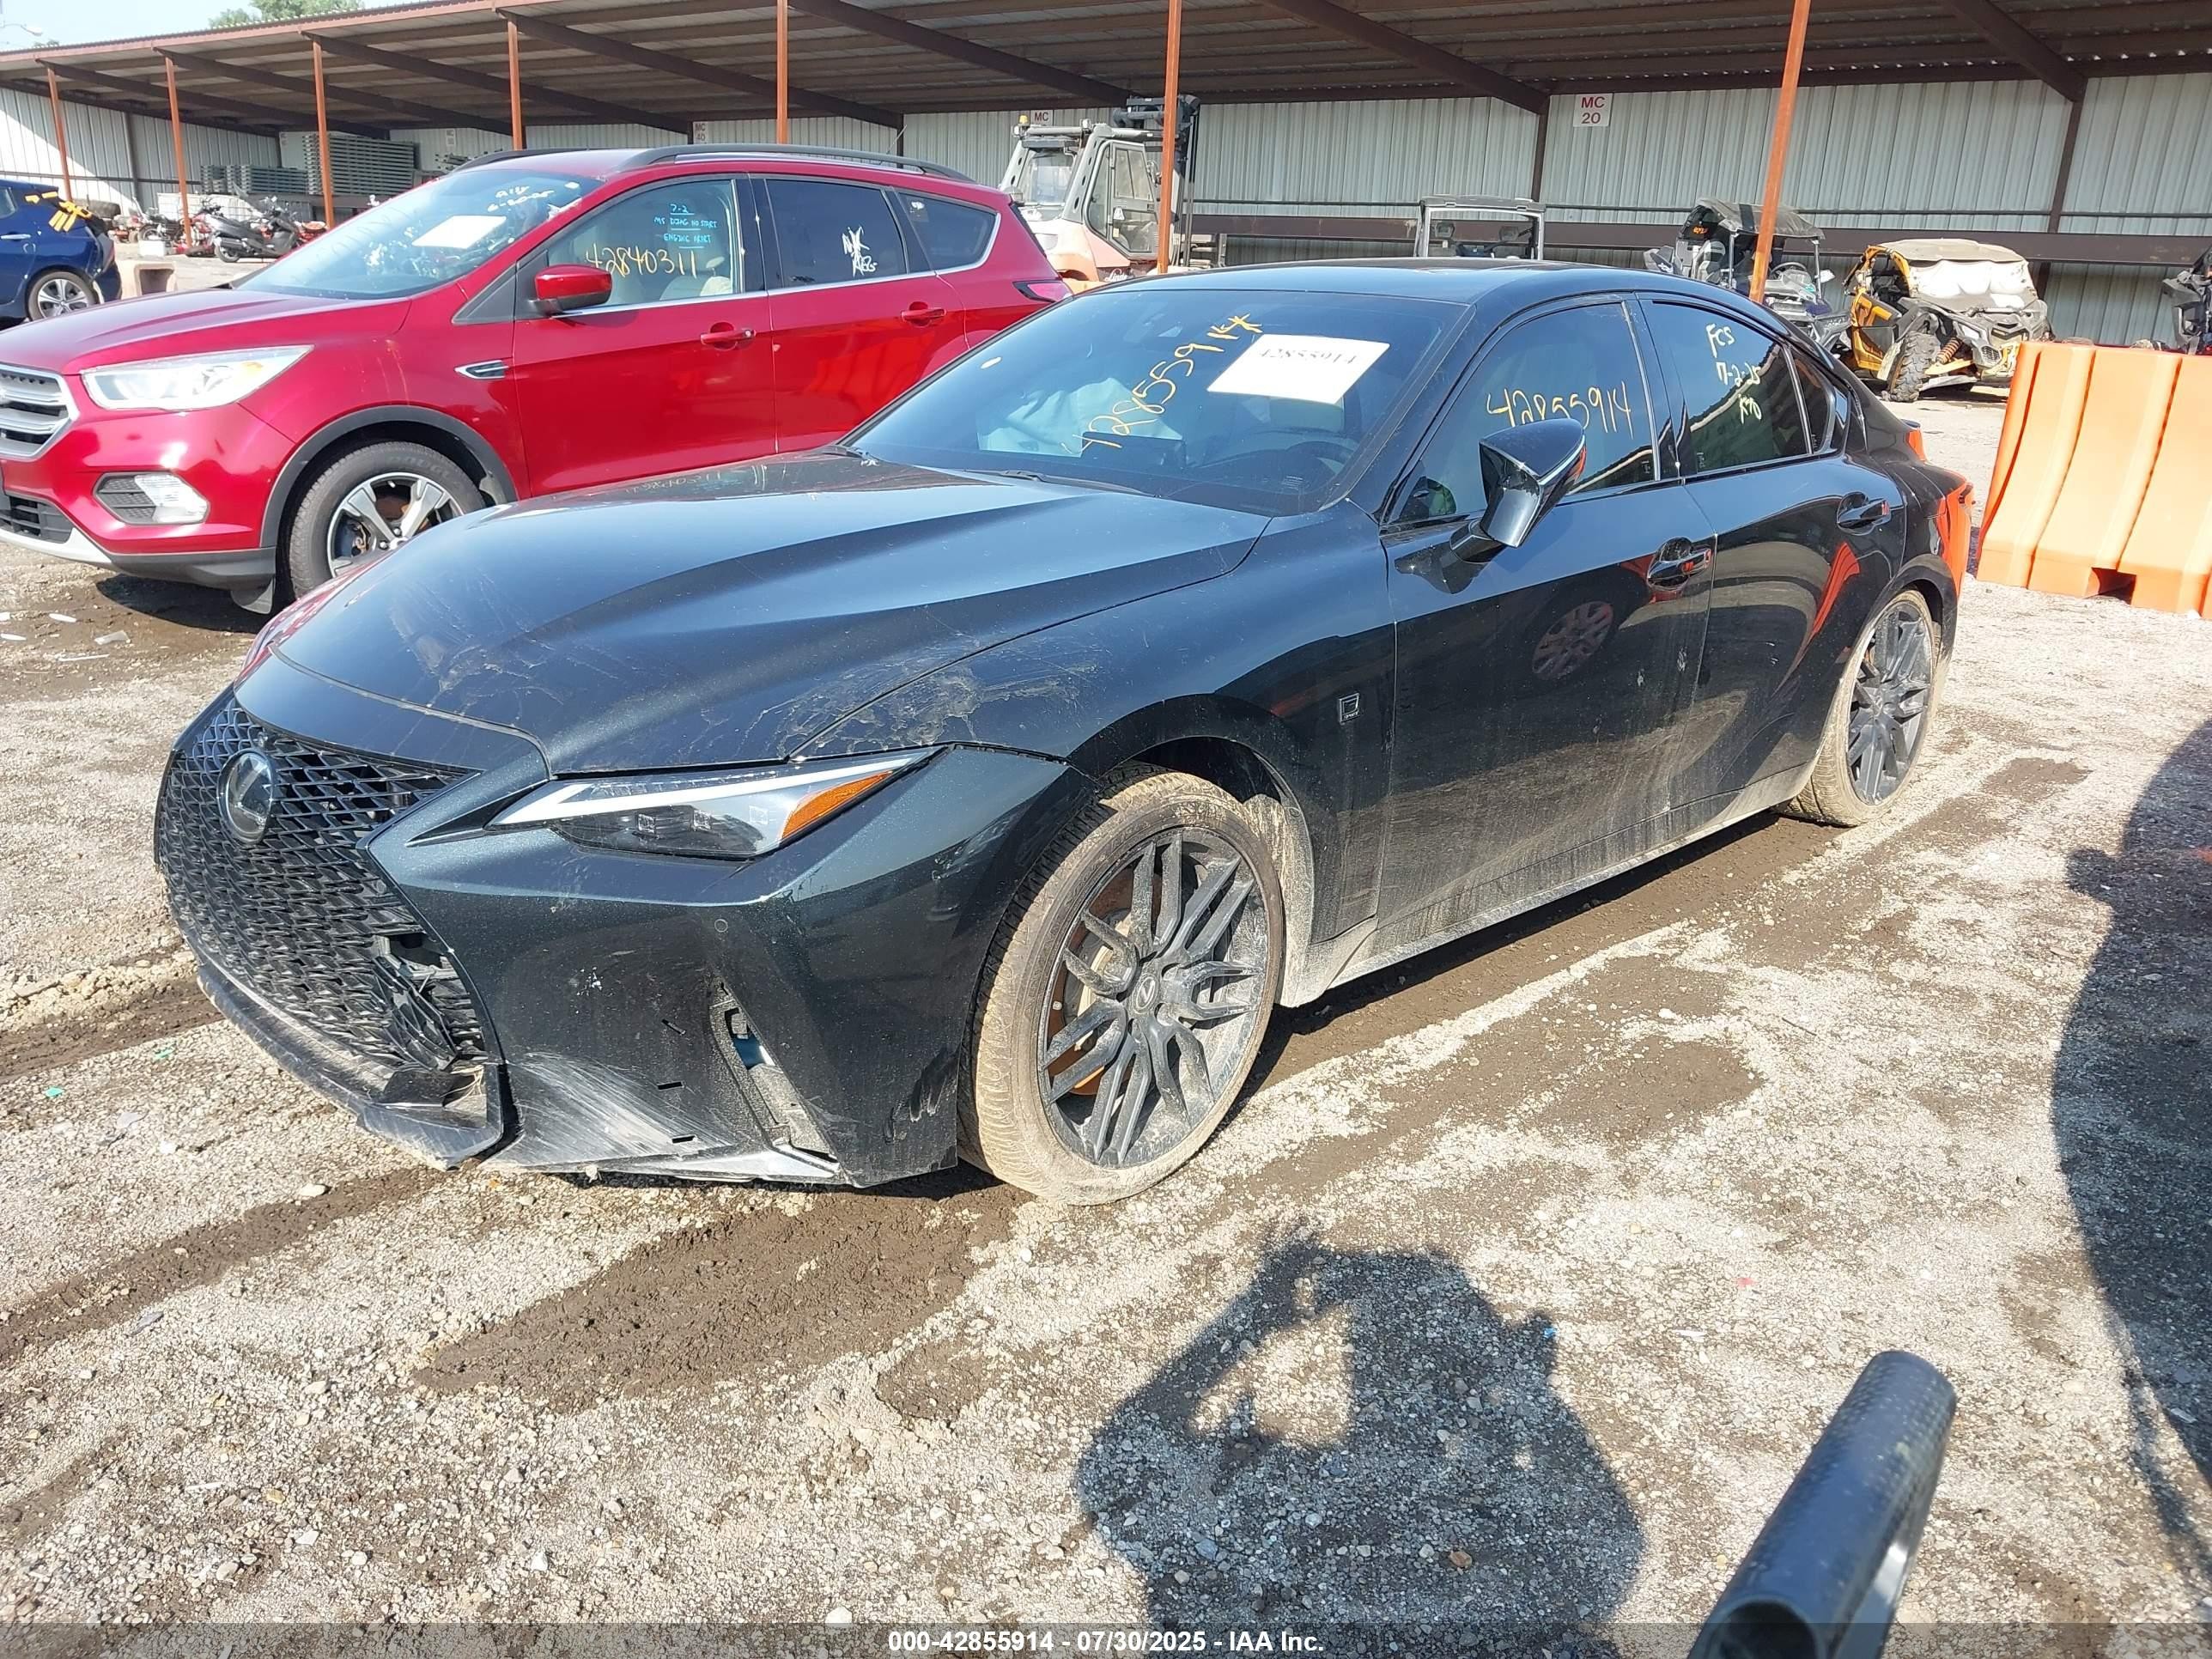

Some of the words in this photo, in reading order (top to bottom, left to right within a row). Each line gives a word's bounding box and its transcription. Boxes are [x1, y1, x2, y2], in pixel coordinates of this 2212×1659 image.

[1581, 95, 1606, 108] MC
[1034, 112, 1049, 122] MC
[1581, 112, 1601, 125] 20
[586, 242, 698, 280] 42840311
